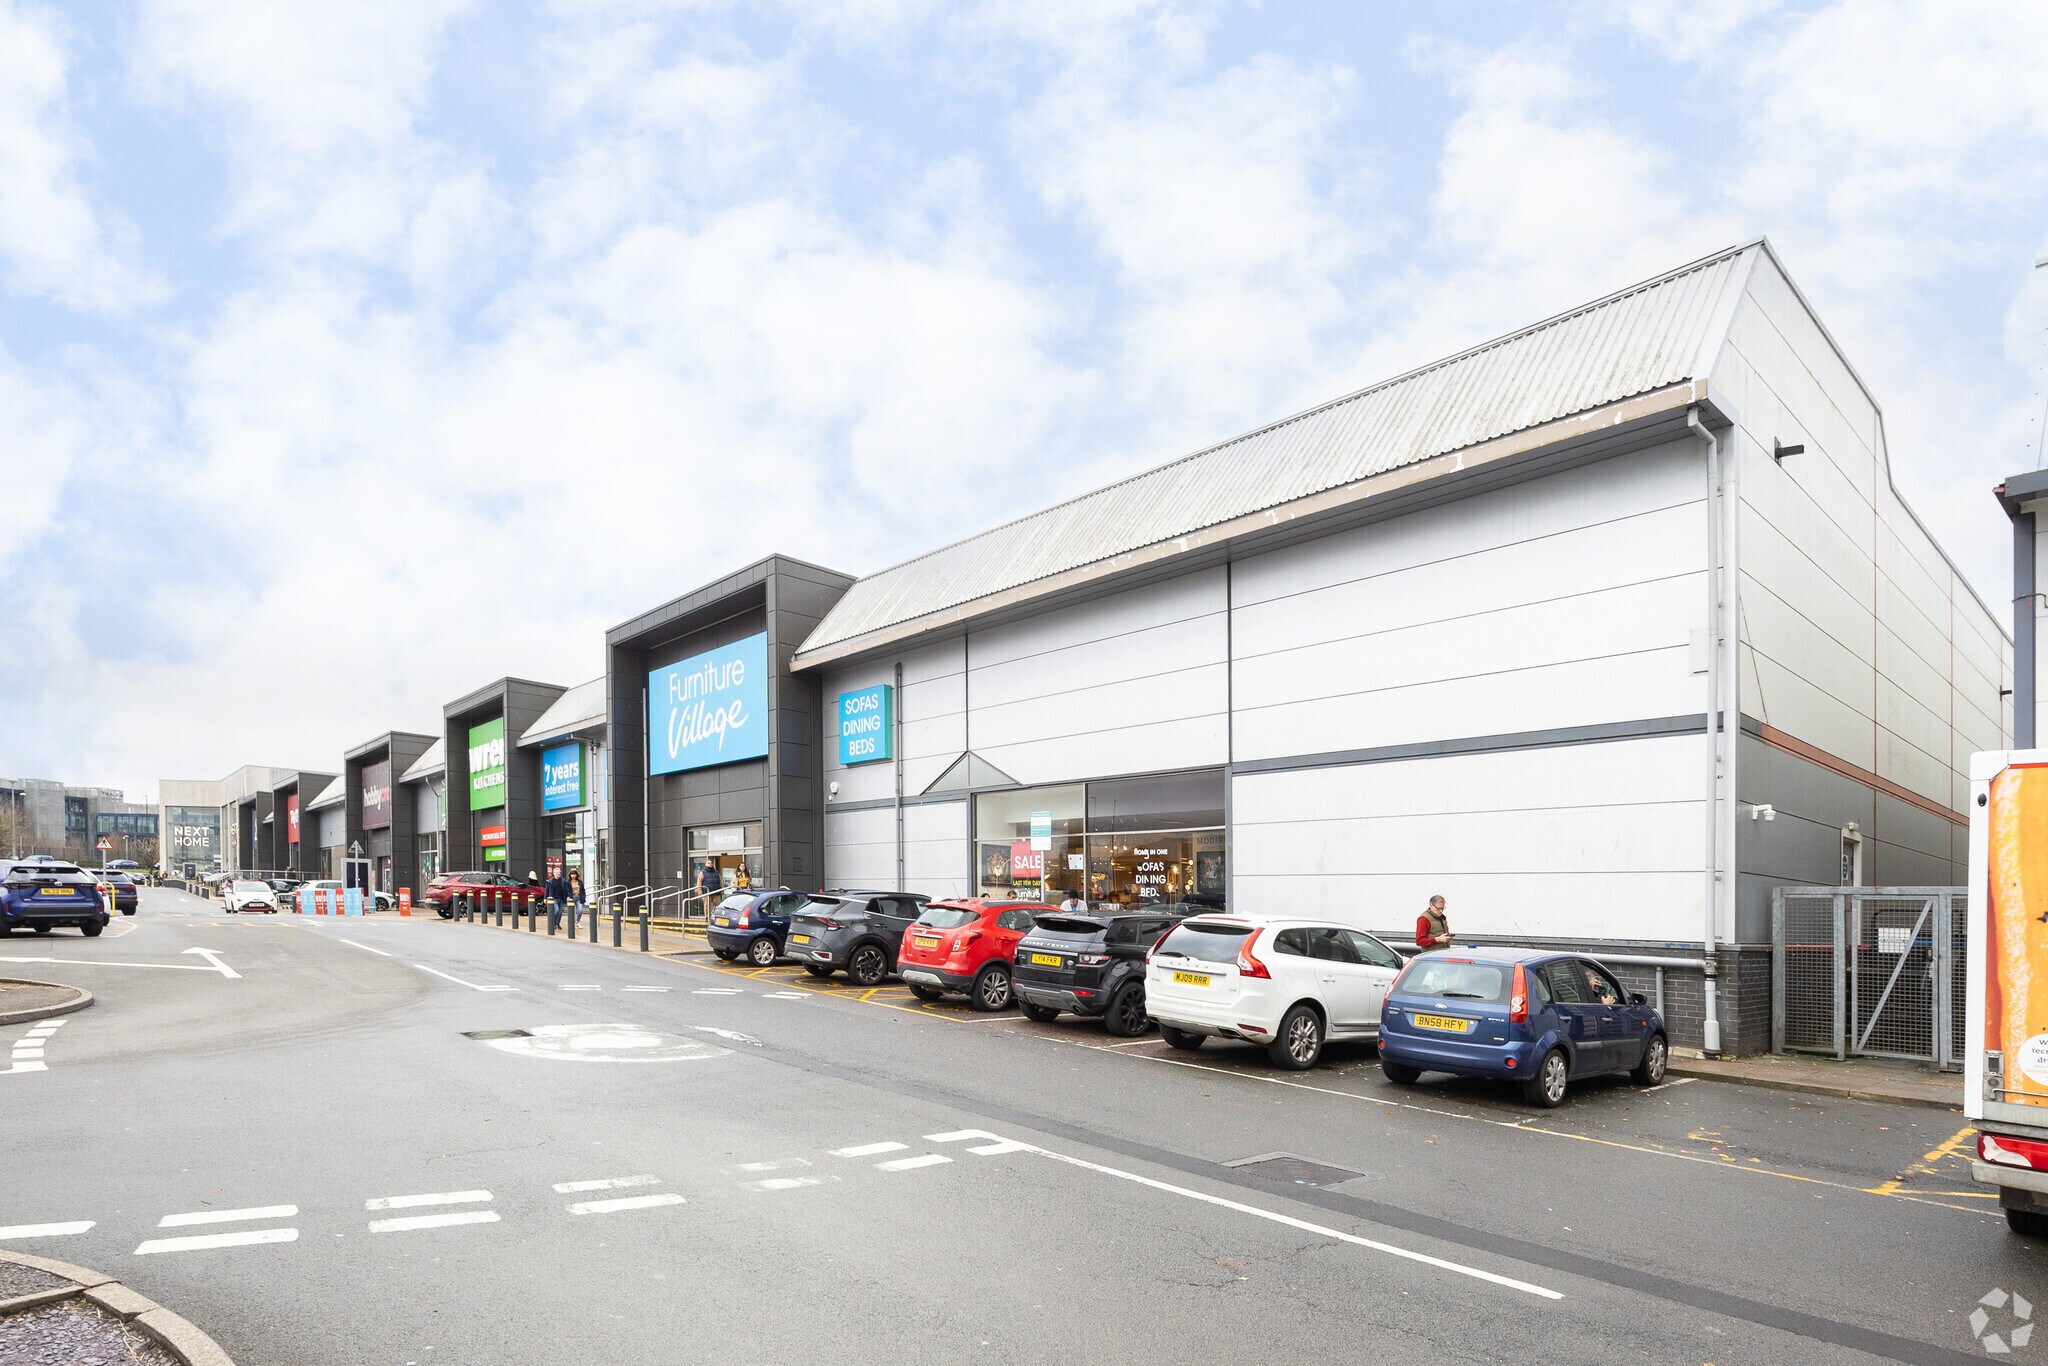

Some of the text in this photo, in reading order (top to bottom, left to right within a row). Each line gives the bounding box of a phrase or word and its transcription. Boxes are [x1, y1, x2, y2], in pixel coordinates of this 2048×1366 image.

[669, 659, 745, 705] Furniture
[845, 693, 878, 715] SOFAS
[668, 699, 749, 760] Village
[843, 715, 881, 737] DINING
[849, 737, 875, 757] BEDS
[474, 771, 505, 790] KITCHENS
[544, 761, 579, 786] 7 years
[544, 780, 579, 796] interest free
[174, 825, 210, 837] NEXT
[174, 836, 210, 847] HOME
[1157, 848, 1168, 856] ONE
[1014, 855, 1041, 870] SALE
[1135, 874, 1167, 885] DINING
[1193, 975, 1208, 985] RRR
[1418, 1016, 1464, 1030] BN58 HFY
